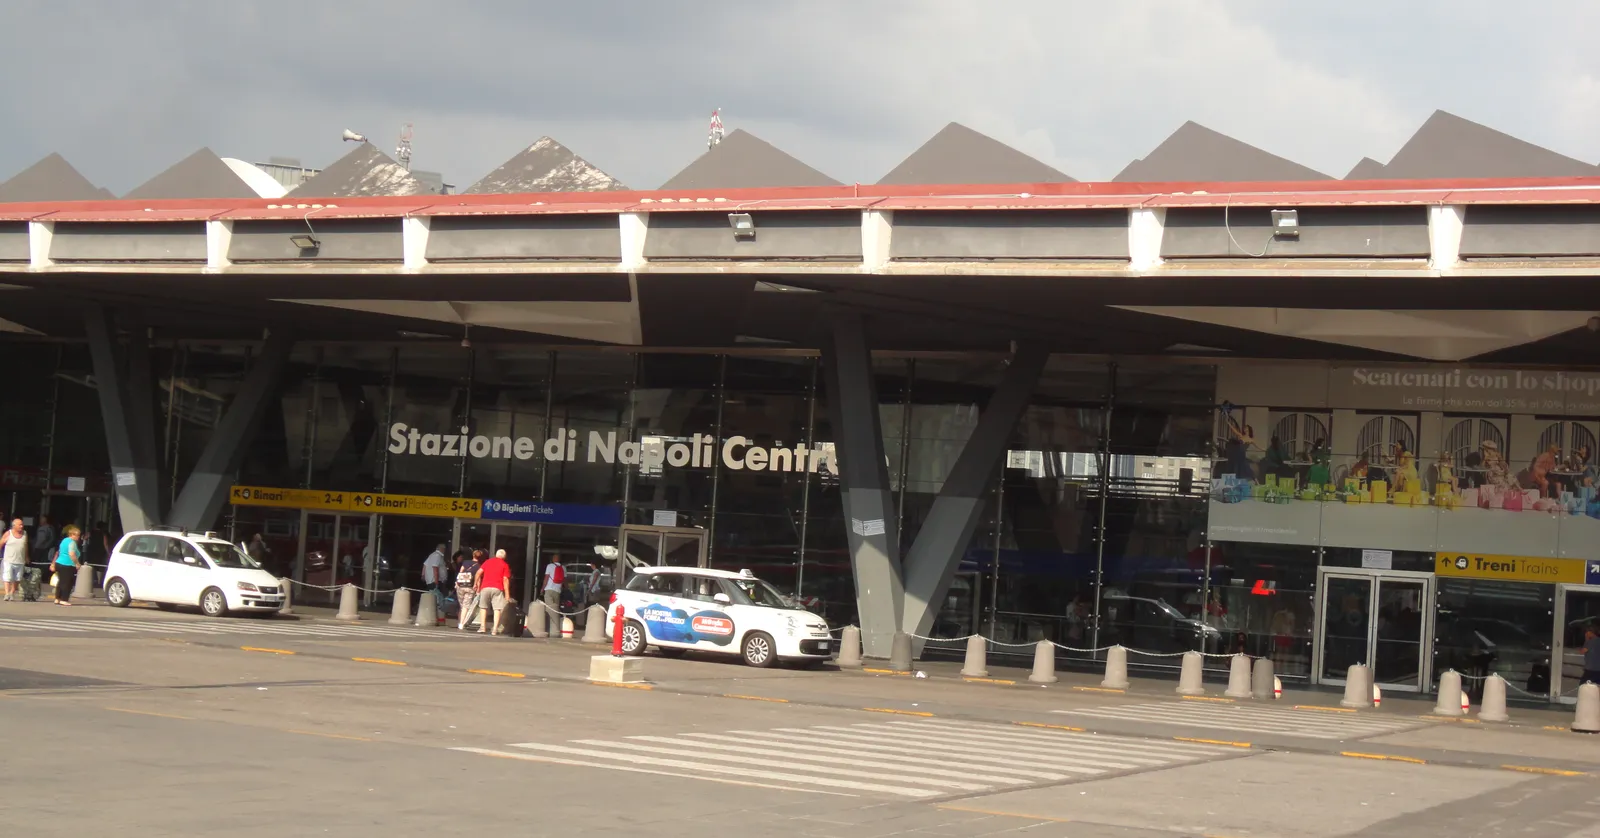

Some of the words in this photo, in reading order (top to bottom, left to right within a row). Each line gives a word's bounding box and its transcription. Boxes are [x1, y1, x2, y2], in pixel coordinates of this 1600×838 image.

[1352, 367, 1461, 388] Scatenati
[1466, 374, 1508, 390] con
[1515, 370, 1539, 391] lo
[388, 422, 535, 460] Stazione
[543, 427, 577, 462] di
[587, 430, 712, 474] Napoli
[253, 489, 283, 501] Binari
[324, 493, 343, 504] 2-4
[376, 496, 408, 508] Binari
[408, 497, 449, 511] Platforms
[451, 501, 478, 513] 5-24
[501, 504, 532, 514] Biglietti
[532, 505, 554, 515] Tickets
[1474, 557, 1516, 573] Treni
[1520, 560, 1559, 575] Trains
